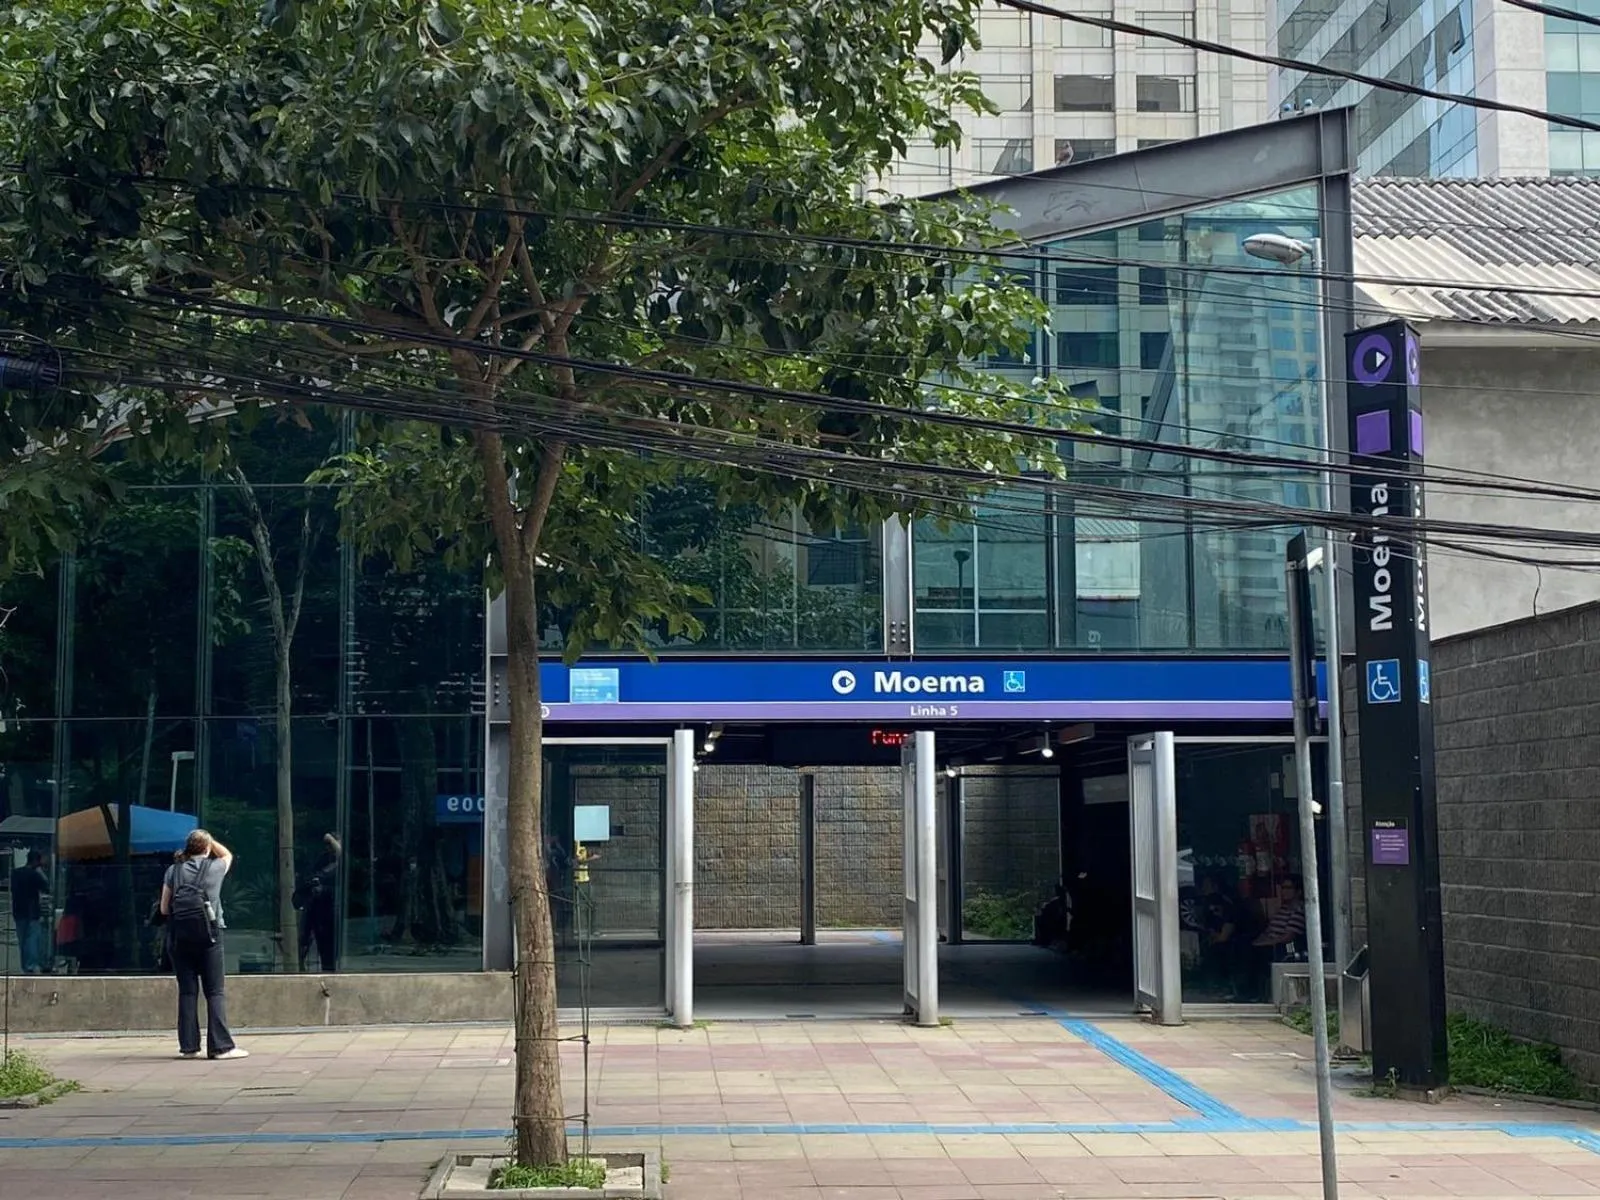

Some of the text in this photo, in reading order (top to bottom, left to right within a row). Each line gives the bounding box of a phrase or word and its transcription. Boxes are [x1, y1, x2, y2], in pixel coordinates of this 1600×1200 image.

[874, 671, 985, 693] Moema
[910, 705, 958, 716] Linha 5
